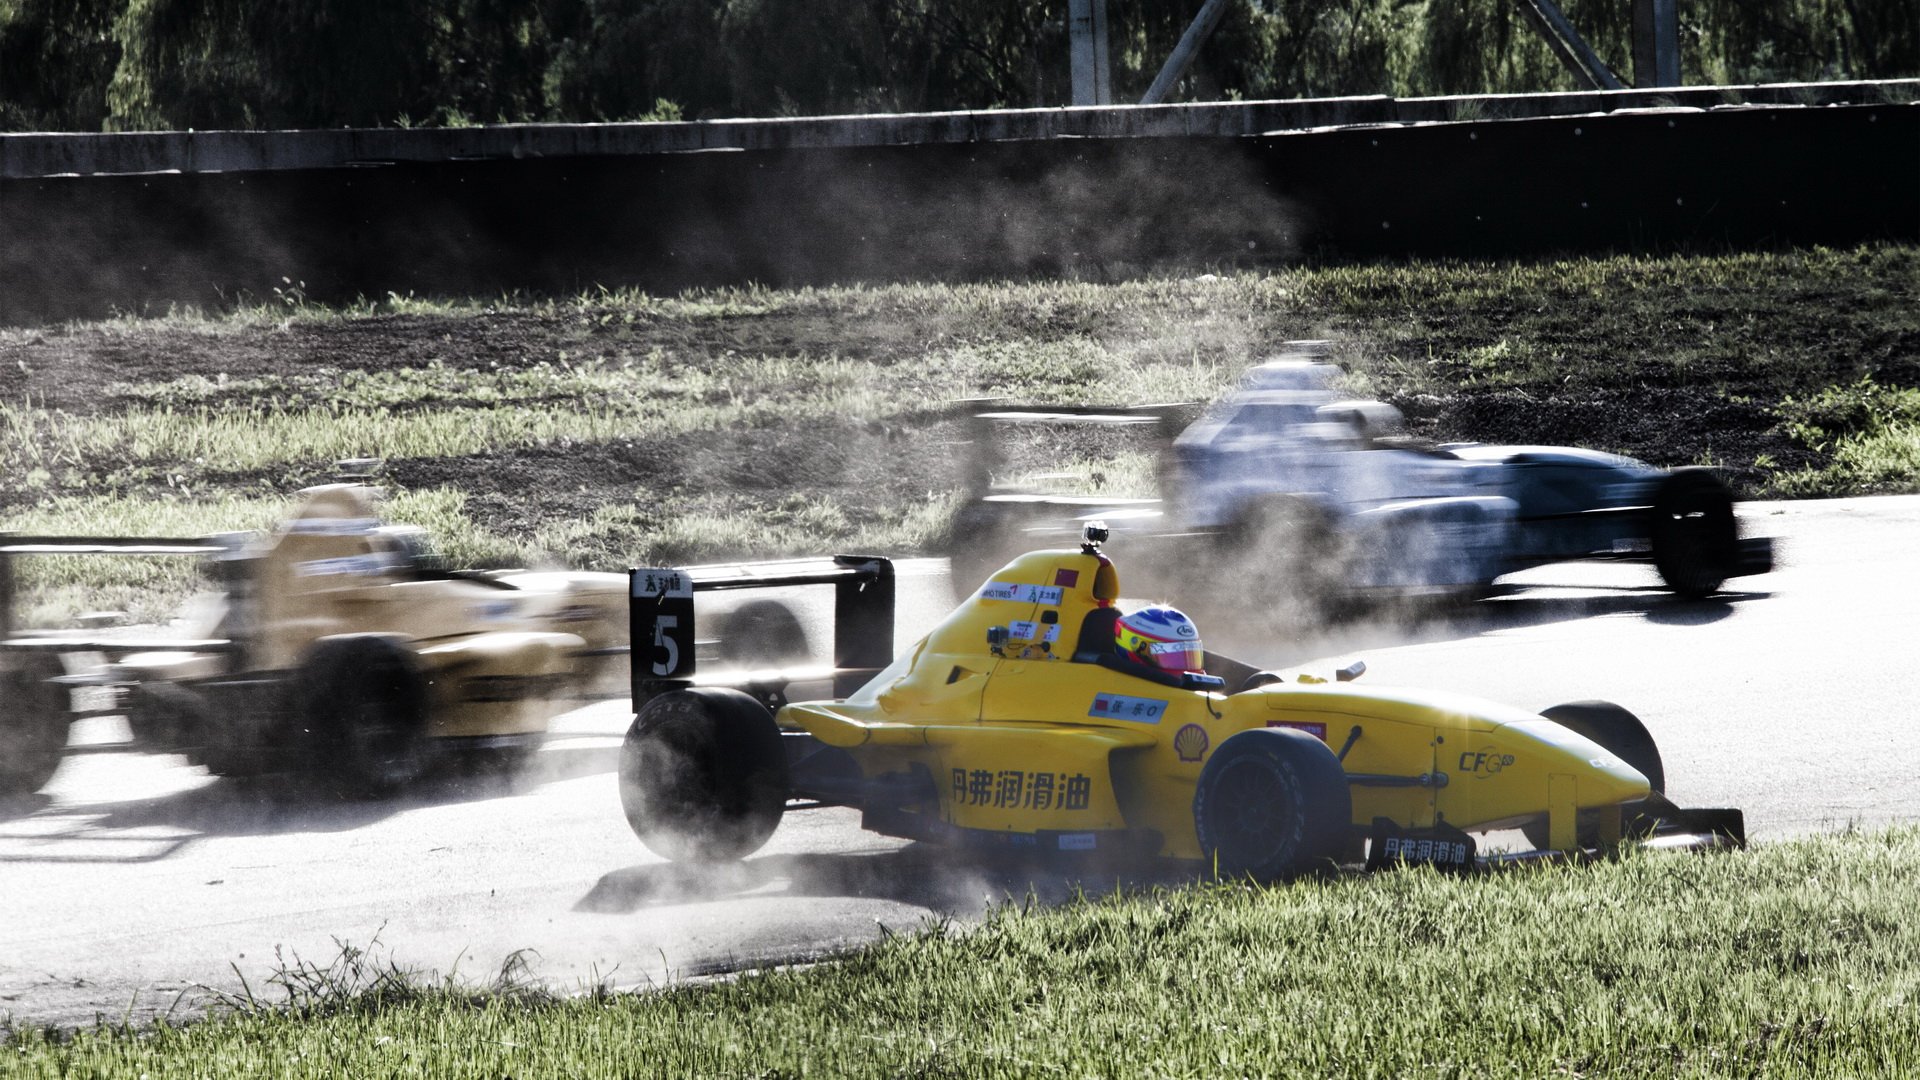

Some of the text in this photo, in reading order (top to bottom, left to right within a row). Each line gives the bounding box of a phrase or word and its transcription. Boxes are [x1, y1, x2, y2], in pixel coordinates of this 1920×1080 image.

[995, 590, 1012, 599] TIRES
[652, 615, 679, 676] 5
[952, 768, 1091, 810] 丹弗润滑油
[1384, 837, 1466, 864] 丹弗润滑油
